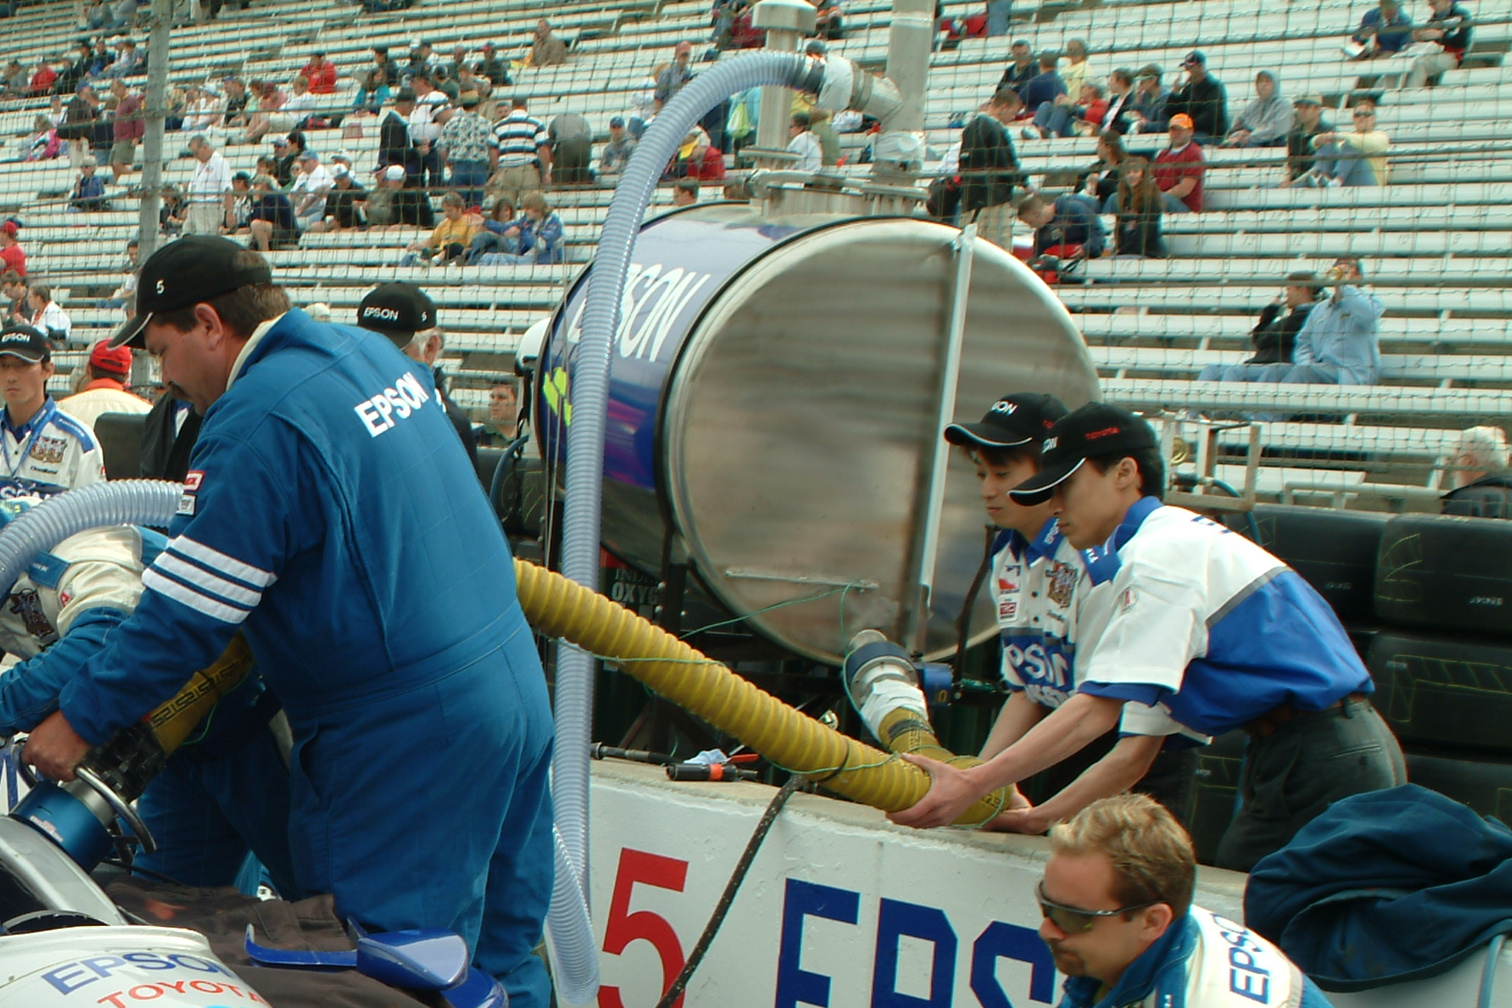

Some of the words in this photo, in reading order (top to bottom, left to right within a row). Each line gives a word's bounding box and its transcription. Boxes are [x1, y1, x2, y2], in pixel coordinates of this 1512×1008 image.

[155, 280, 165, 295] 5
[363, 306, 399, 321] EPSON
[567, 263, 711, 362] SON
[1, 332, 31, 343] EPSON
[353, 371, 430, 438] EPSON
[1212, 913, 1270, 1004] EPSO
